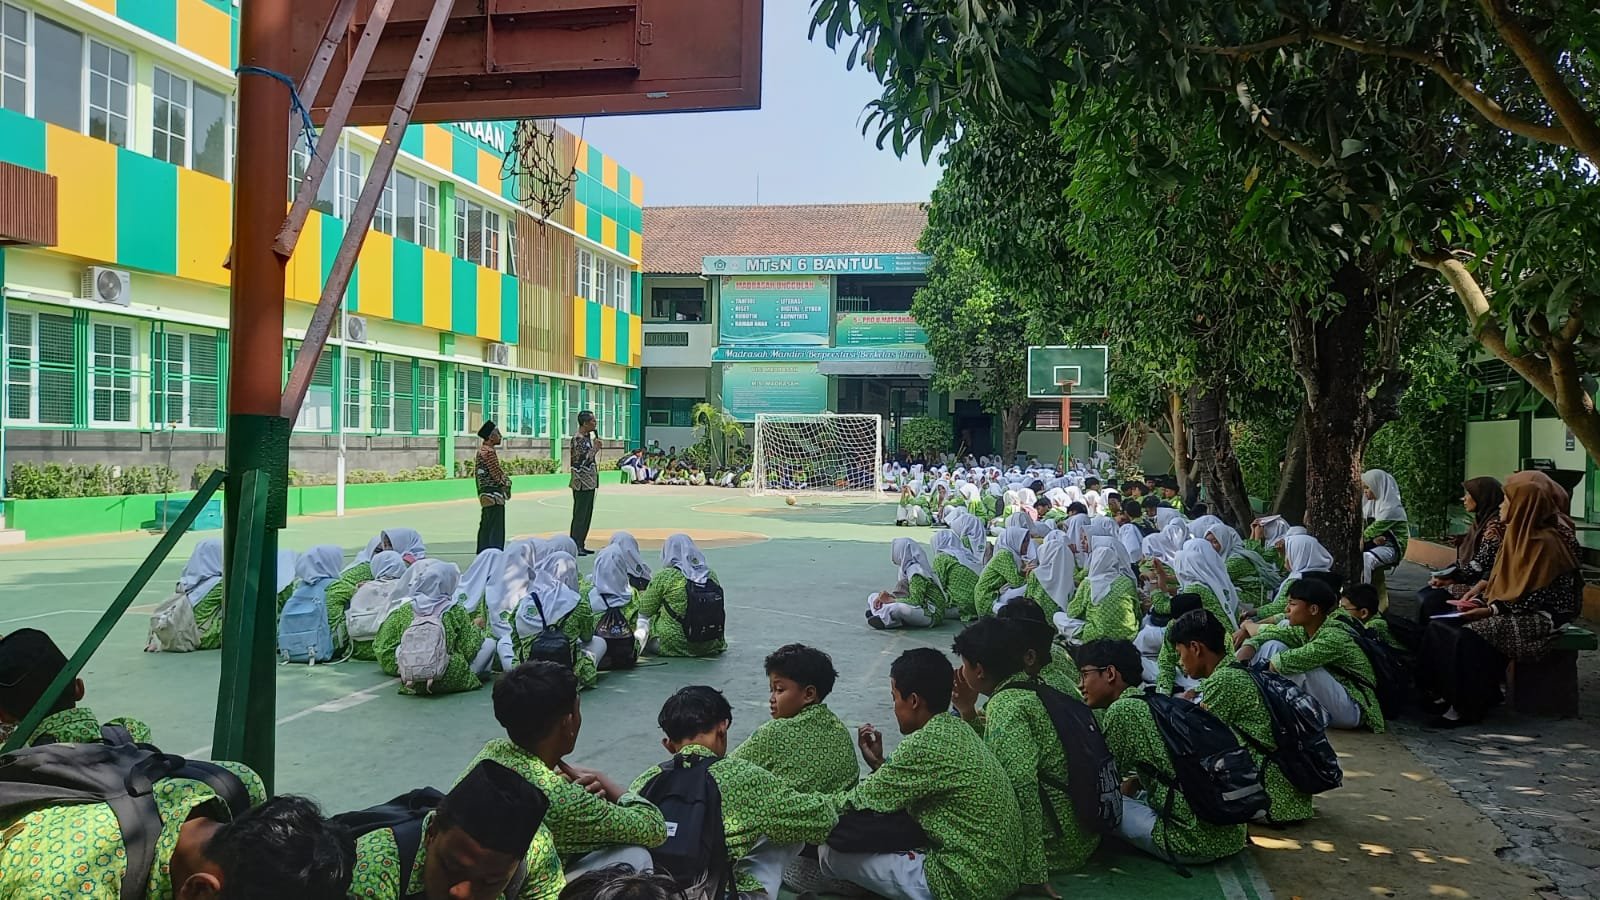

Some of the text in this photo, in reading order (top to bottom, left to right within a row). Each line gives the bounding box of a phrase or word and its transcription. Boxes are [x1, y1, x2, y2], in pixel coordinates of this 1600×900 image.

[746, 258, 792, 271] MTsN
[797, 258, 807, 271] 6
[813, 257, 884, 271] BANTUL
[735, 281, 814, 290] MADRASAH UNGGULAN
[725, 349, 769, 358] Madrasah
[770, 349, 805, 358] Mandiri
[806, 349, 857, 360] Berprestasi
